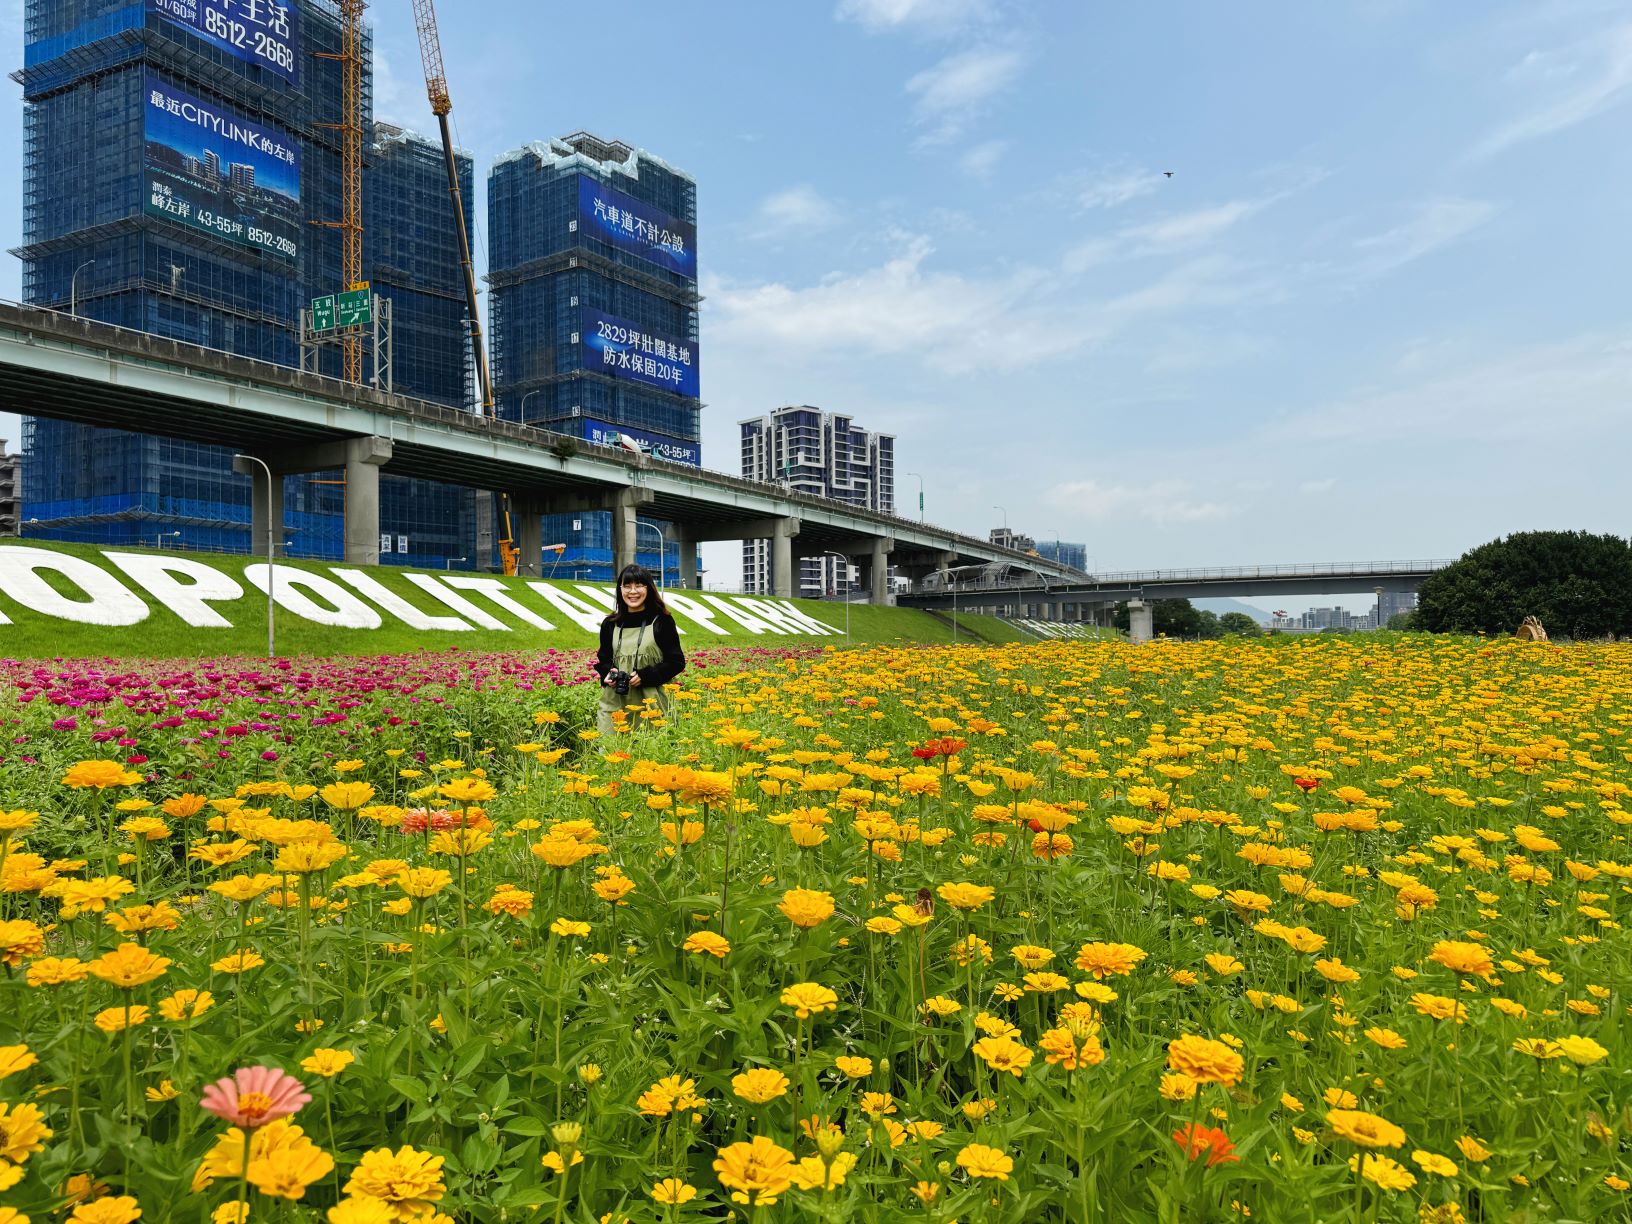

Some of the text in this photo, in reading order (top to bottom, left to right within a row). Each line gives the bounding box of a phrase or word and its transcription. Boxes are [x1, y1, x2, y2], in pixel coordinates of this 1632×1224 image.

[205, 7, 293, 73] 8512-2668
[151, 192, 296, 257] 峰左岸 43-55坪 8512-2668
[597, 320, 690, 365] 2829坪壯闊基地
[603, 345, 683, 385] 防水保固20年
[658, 588, 846, 636] PARK
